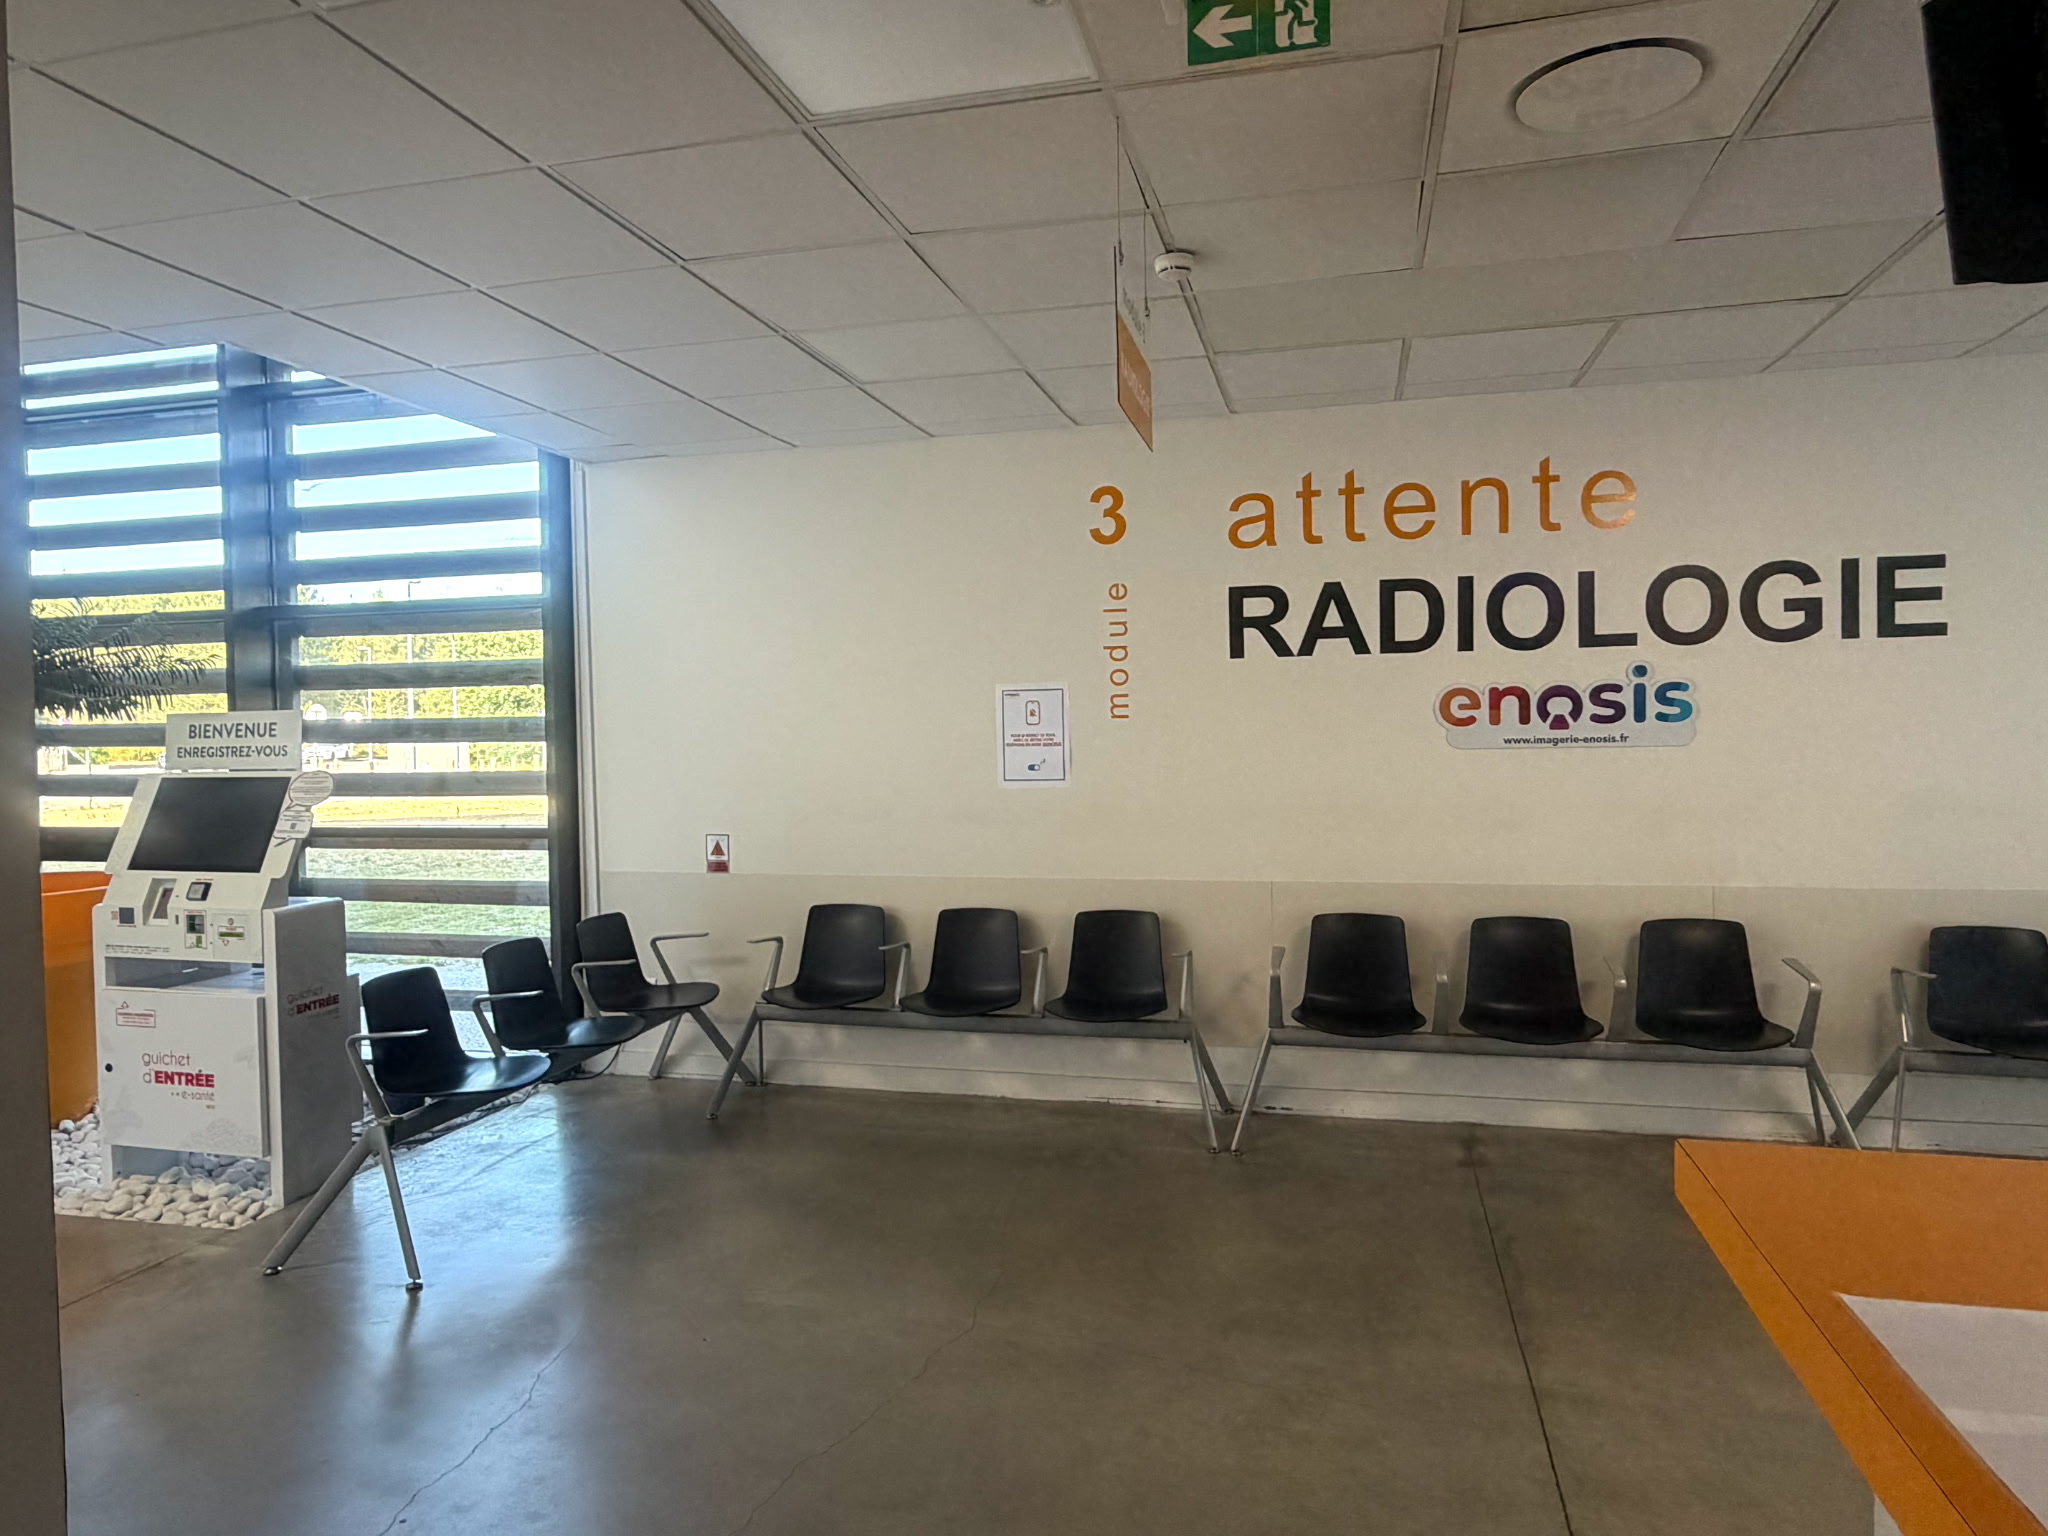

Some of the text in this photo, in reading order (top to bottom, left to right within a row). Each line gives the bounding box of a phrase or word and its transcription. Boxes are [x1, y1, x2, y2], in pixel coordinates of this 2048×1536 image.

[1089, 485, 1128, 546] 3
[1227, 457, 1638, 550] attente
[1228, 553, 1949, 660] RADIOLOGIE
[1102, 583, 1131, 720] module
[1439, 664, 1693, 730] enosis
[176, 745, 288, 759] ENREGISTREZ-VOUS
[188, 722, 278, 740] BIENVENUE
[1503, 733, 1630, 747] www.imagerie-enosis.fr
[141, 1050, 191, 1067] guichet
